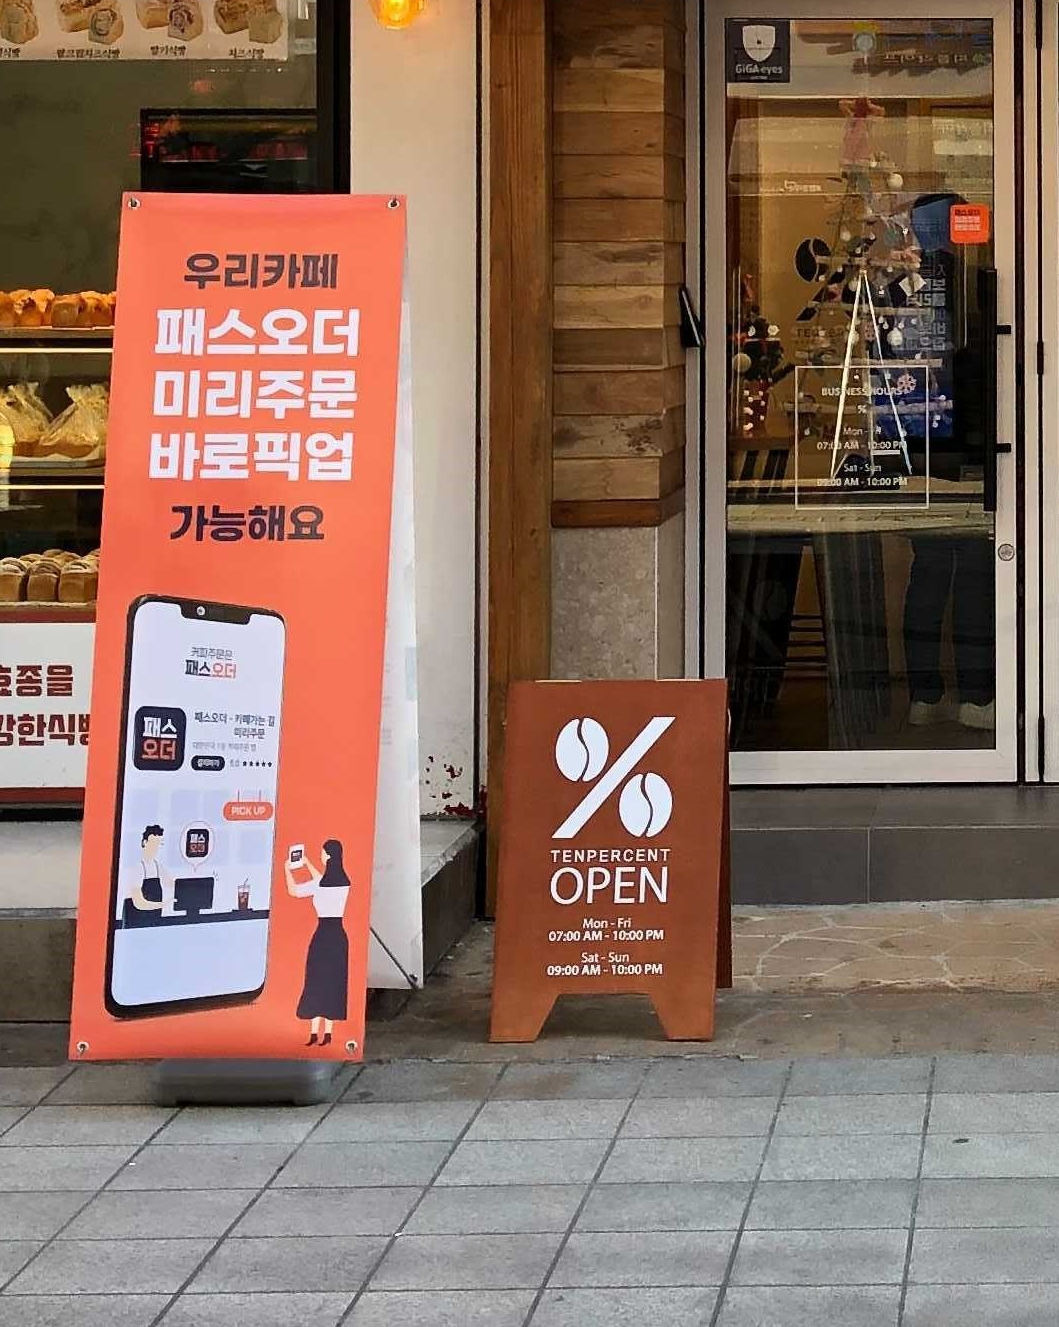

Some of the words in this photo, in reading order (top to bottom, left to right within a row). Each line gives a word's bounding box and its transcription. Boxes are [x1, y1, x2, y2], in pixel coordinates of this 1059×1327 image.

[184, 253, 338, 289] 우리카페
[154, 308, 360, 356] 패스오더
[153, 370, 357, 419] 미리주문
[844, 442, 859, 450] AM
[149, 432, 354, 481] 바로픽업
[844, 477, 859, 486] AM
[868, 477, 891, 486] 10:00
[170, 505, 324, 541] 가능해요
[185, 659, 236, 679] 패스오더
[142, 717, 178, 738] 패스
[141, 739, 176, 761] 오더
[231, 806, 252, 816] PICK
[253, 806, 267, 815] UP
[550, 848, 671, 863] TENPERCENT
[550, 866, 668, 905] OPEN
[582, 918, 608, 929] Mon
[617, 917, 632, 929] Fri
[548, 931, 580, 942] 07:00
[581, 931, 603, 942] AM
[612, 930, 644, 941] 10:00
[645, 930, 664, 941] PM
[581, 951, 600, 963] Sat
[608, 951, 630, 963] Sun
[547, 965, 579, 976] 09:00
[581, 965, 602, 976] AM
[610, 964, 643, 975] 10:00
[644, 964, 663, 975] PM
